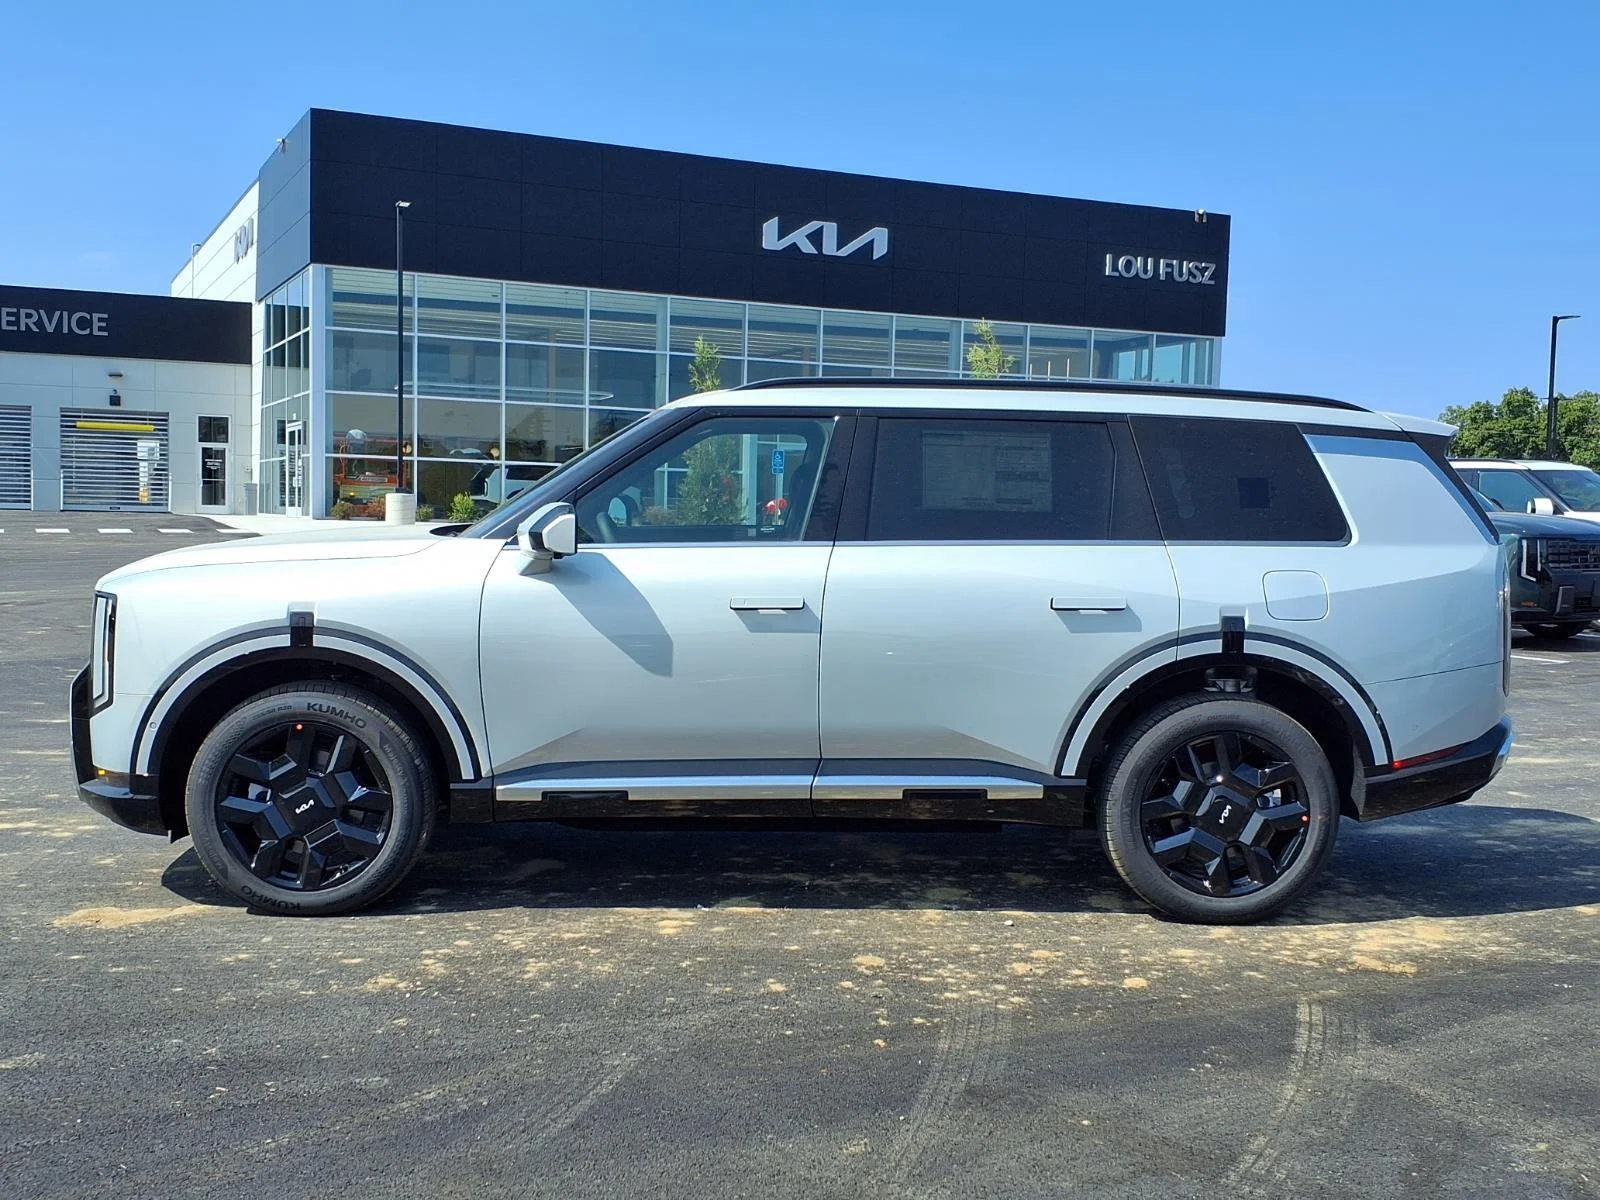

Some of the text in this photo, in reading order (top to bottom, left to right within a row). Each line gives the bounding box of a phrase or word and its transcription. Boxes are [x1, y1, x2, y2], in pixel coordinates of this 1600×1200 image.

[762, 216, 888, 260] KIA
[1105, 253, 1216, 285] LOU FUSZ
[0, 306, 109, 336] ERVICE
[307, 702, 367, 729] KUMHO
[241, 885, 301, 910] KUMHO
